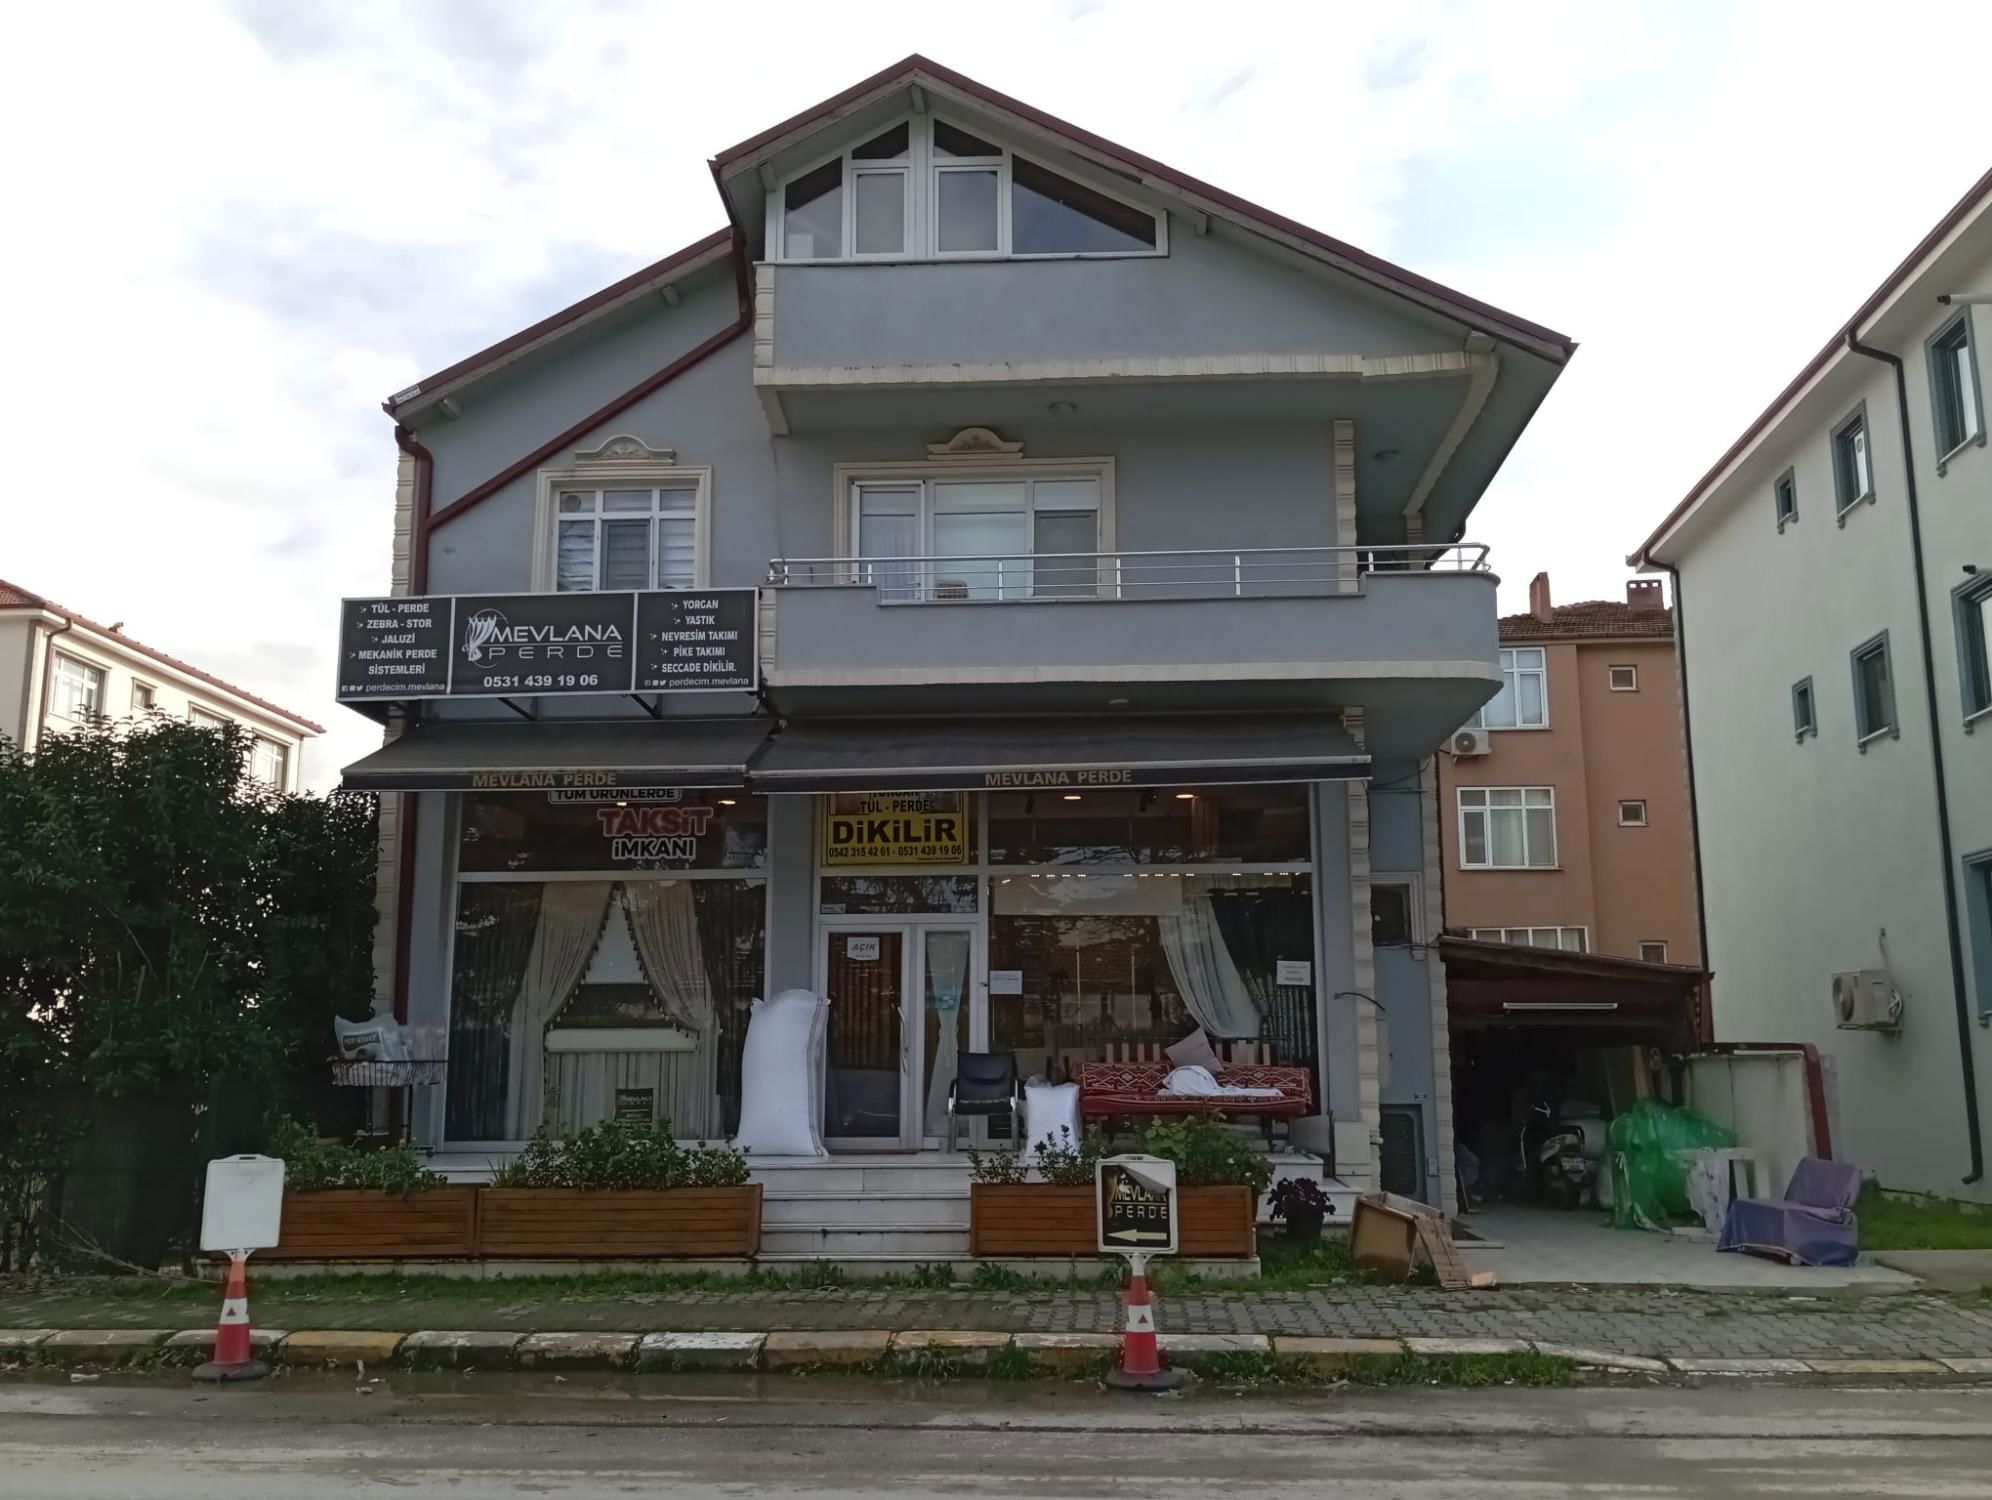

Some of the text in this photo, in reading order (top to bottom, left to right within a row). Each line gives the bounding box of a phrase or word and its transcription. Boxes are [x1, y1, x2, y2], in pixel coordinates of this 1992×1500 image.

[371, 603, 390, 614] TÜL
[398, 603, 430, 613] PERDE
[682, 599, 719, 610] YORGAN
[366, 619, 399, 629] ZEBRA
[406, 619, 432, 628] STOR
[685, 615, 716, 625] YASTIK
[381, 632, 416, 644] JALUZİ
[490, 625, 622, 642] MEVLANA
[661, 629, 738, 642] NEVRESİM TAKIMI
[358, 648, 438, 660] MEKANİK PERDE
[488, 645, 622, 659] PERDE
[673, 645, 726, 657] PİKE TAKIMI
[368, 663, 426, 675] SİSTEMLERİ
[661, 663, 701, 673] SECCADE
[483, 674, 599, 688] 0531 439 19 06
[472, 772, 617, 788] MEVLANA PERDE
[984, 769, 1132, 787] MEVLANA PERDE
[893, 799, 930, 812] PERDE
[829, 846, 849, 858] 0542
[852, 846, 866, 857] 315
[868, 846, 878, 856] 42
[880, 846, 890, 856] 61
[898, 845, 919, 856] 0531
[921, 845, 936, 855] 439
[939, 845, 949, 855] 19
[951, 844, 962, 855] 06
[1115, 1205, 1168, 1219] PERDE
